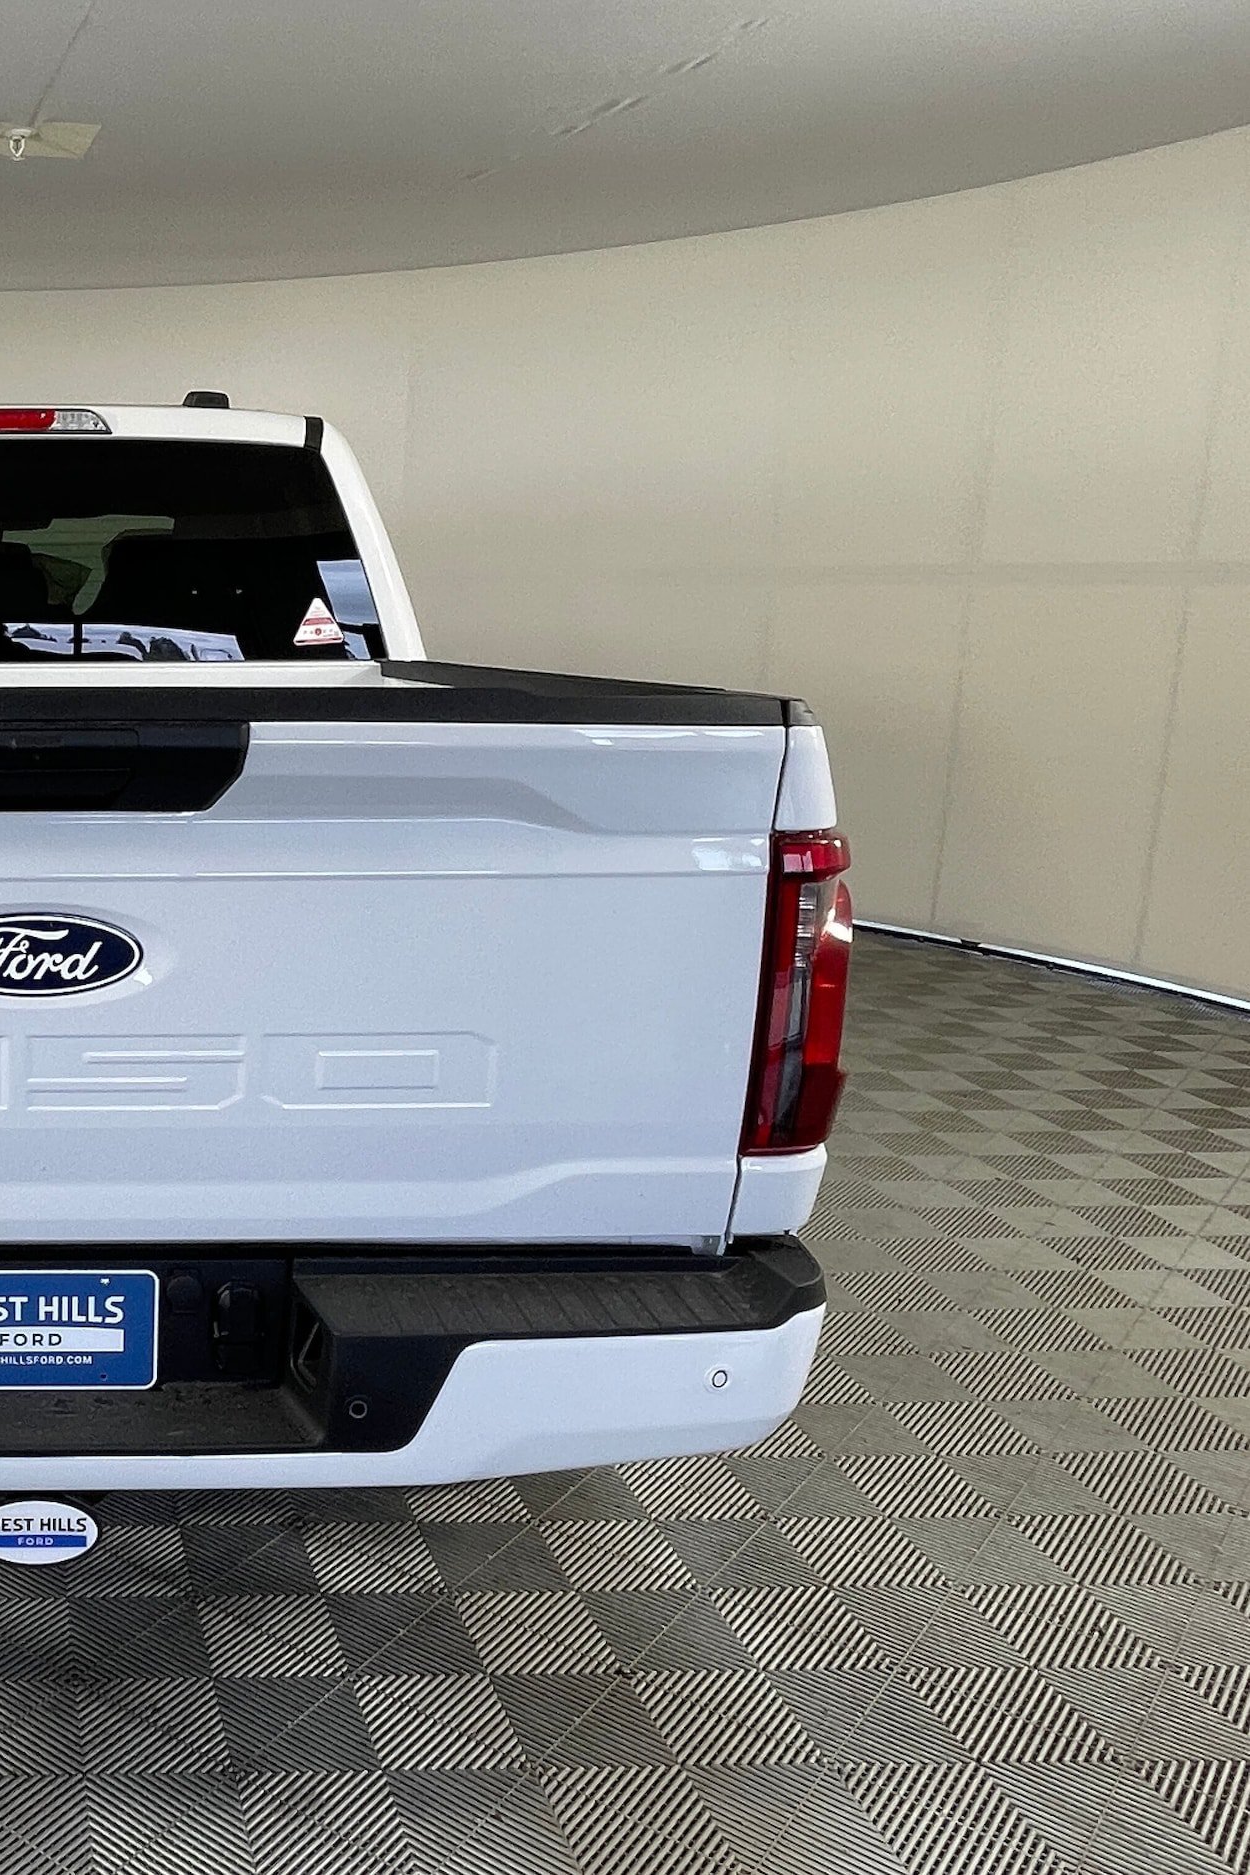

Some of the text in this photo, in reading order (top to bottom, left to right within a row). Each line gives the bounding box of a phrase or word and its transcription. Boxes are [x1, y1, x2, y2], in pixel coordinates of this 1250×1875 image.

[39, 1296, 125, 1324] HILLS
[0, 1333, 62, 1346] FORD
[41, 1518, 87, 1532] HILLS
[18, 1537, 54, 1545] FORD
